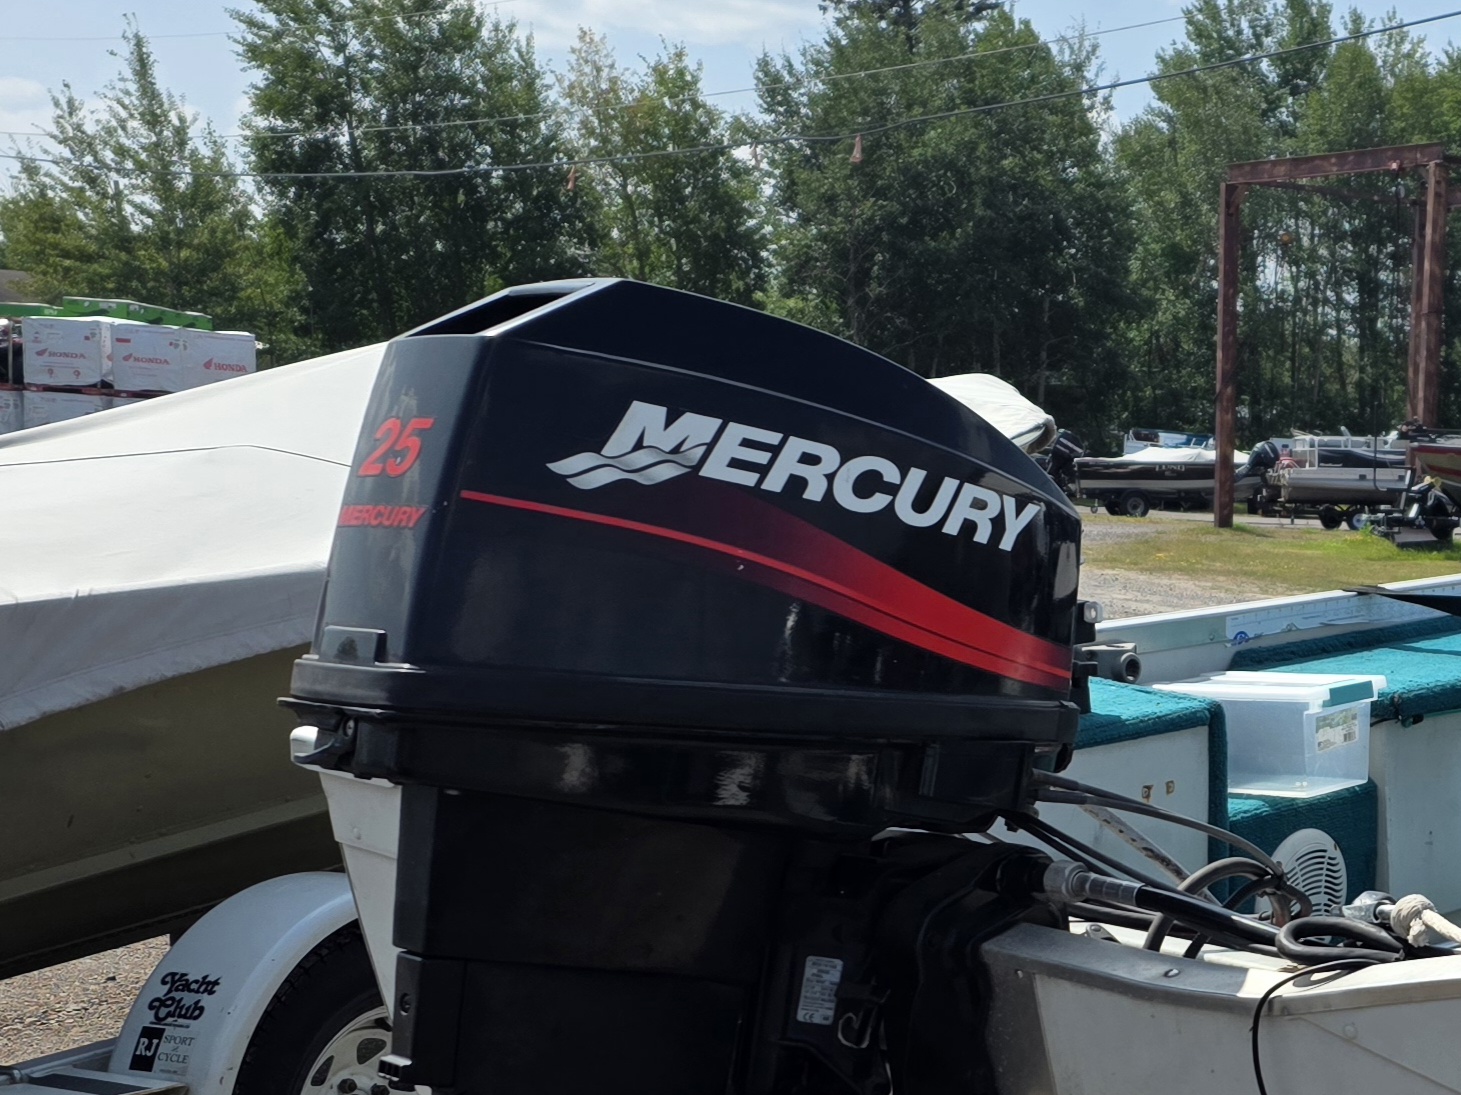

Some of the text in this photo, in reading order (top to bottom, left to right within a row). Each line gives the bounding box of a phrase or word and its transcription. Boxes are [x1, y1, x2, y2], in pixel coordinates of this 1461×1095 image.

[48, 350, 86, 360] HONDA
[133, 356, 170, 366] HONDA
[213, 362, 248, 373] HONDA
[357, 417, 435, 478] 25
[600, 400, 1040, 552] MERCURY
[338, 504, 427, 528] MERCURY
[160, 971, 223, 997] Yacht
[148, 995, 205, 1022] Club
[135, 1037, 160, 1056] RJ
[163, 1034, 196, 1047] SPORT
[157, 1051, 190, 1065] CYCLE
